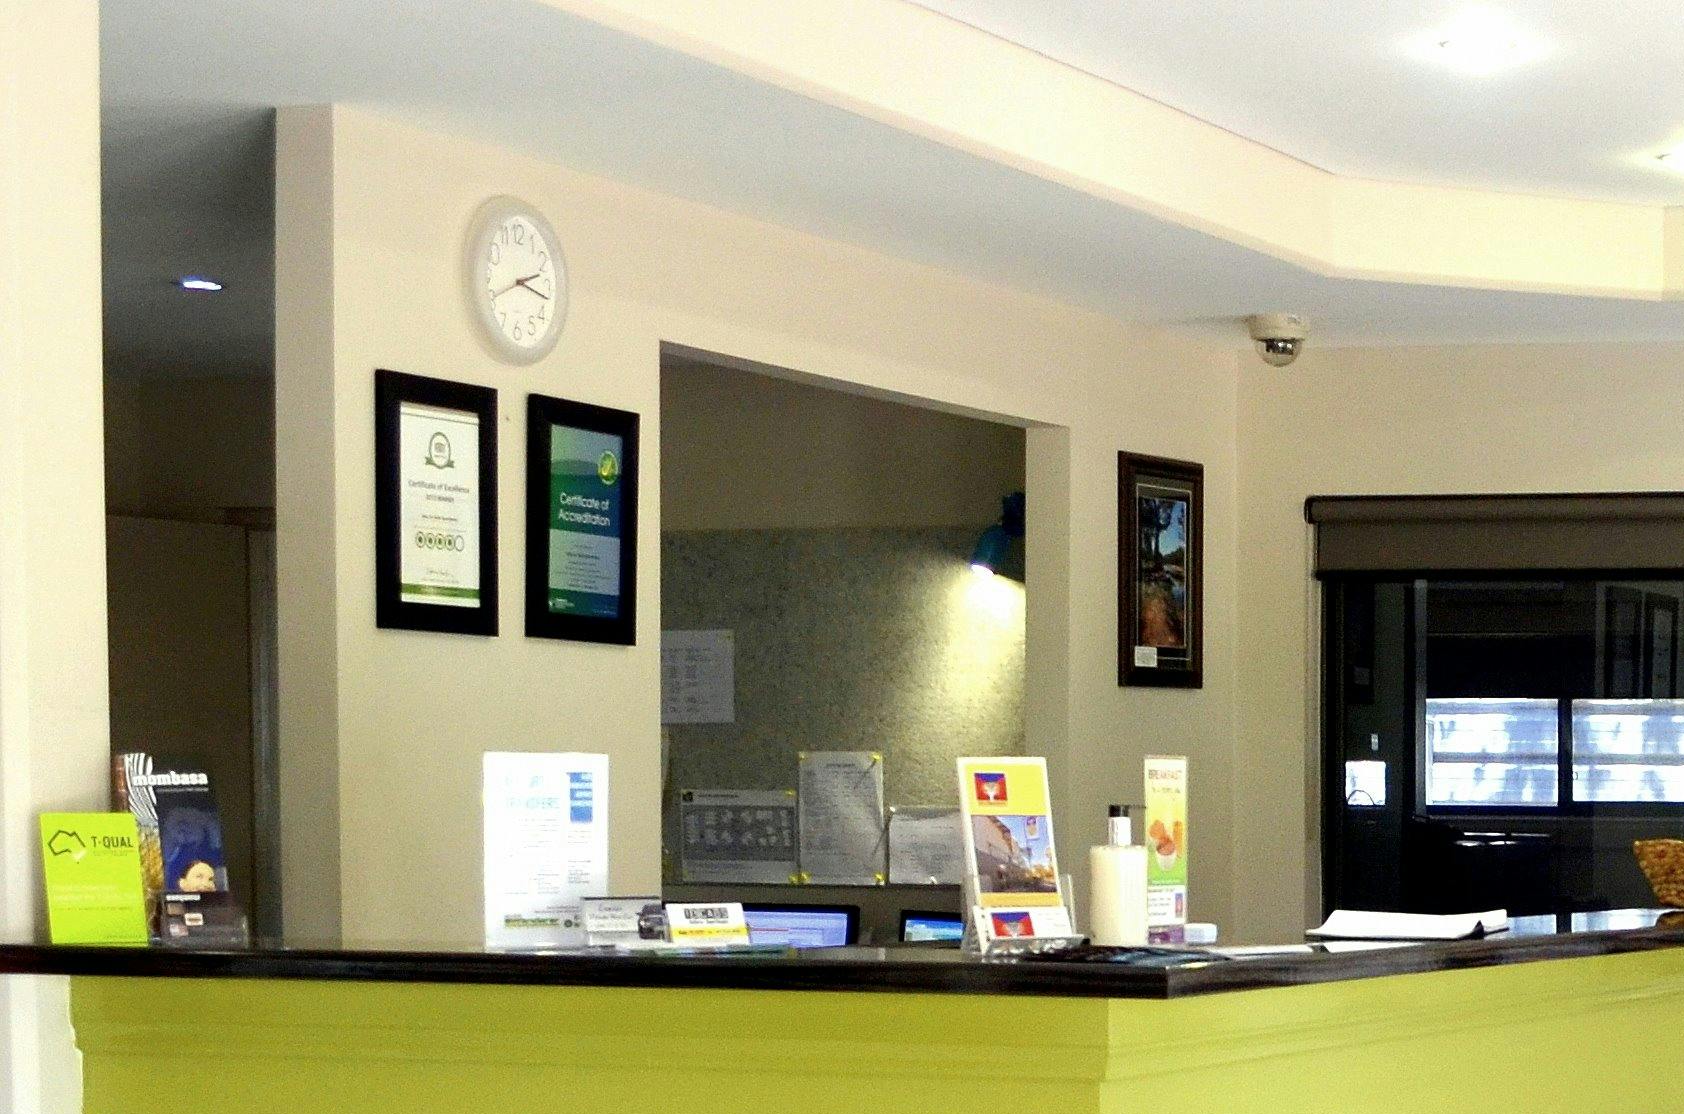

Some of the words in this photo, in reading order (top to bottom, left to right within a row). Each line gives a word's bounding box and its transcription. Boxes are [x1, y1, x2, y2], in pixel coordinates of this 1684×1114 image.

[512, 223, 524, 246] 12
[538, 250, 549, 273] 2
[513, 319, 523, 342] 6
[528, 314, 537, 337] 5
[560, 491, 600, 510] Certificate
[601, 499, 610, 511] of
[559, 507, 611, 528] Accreditation
